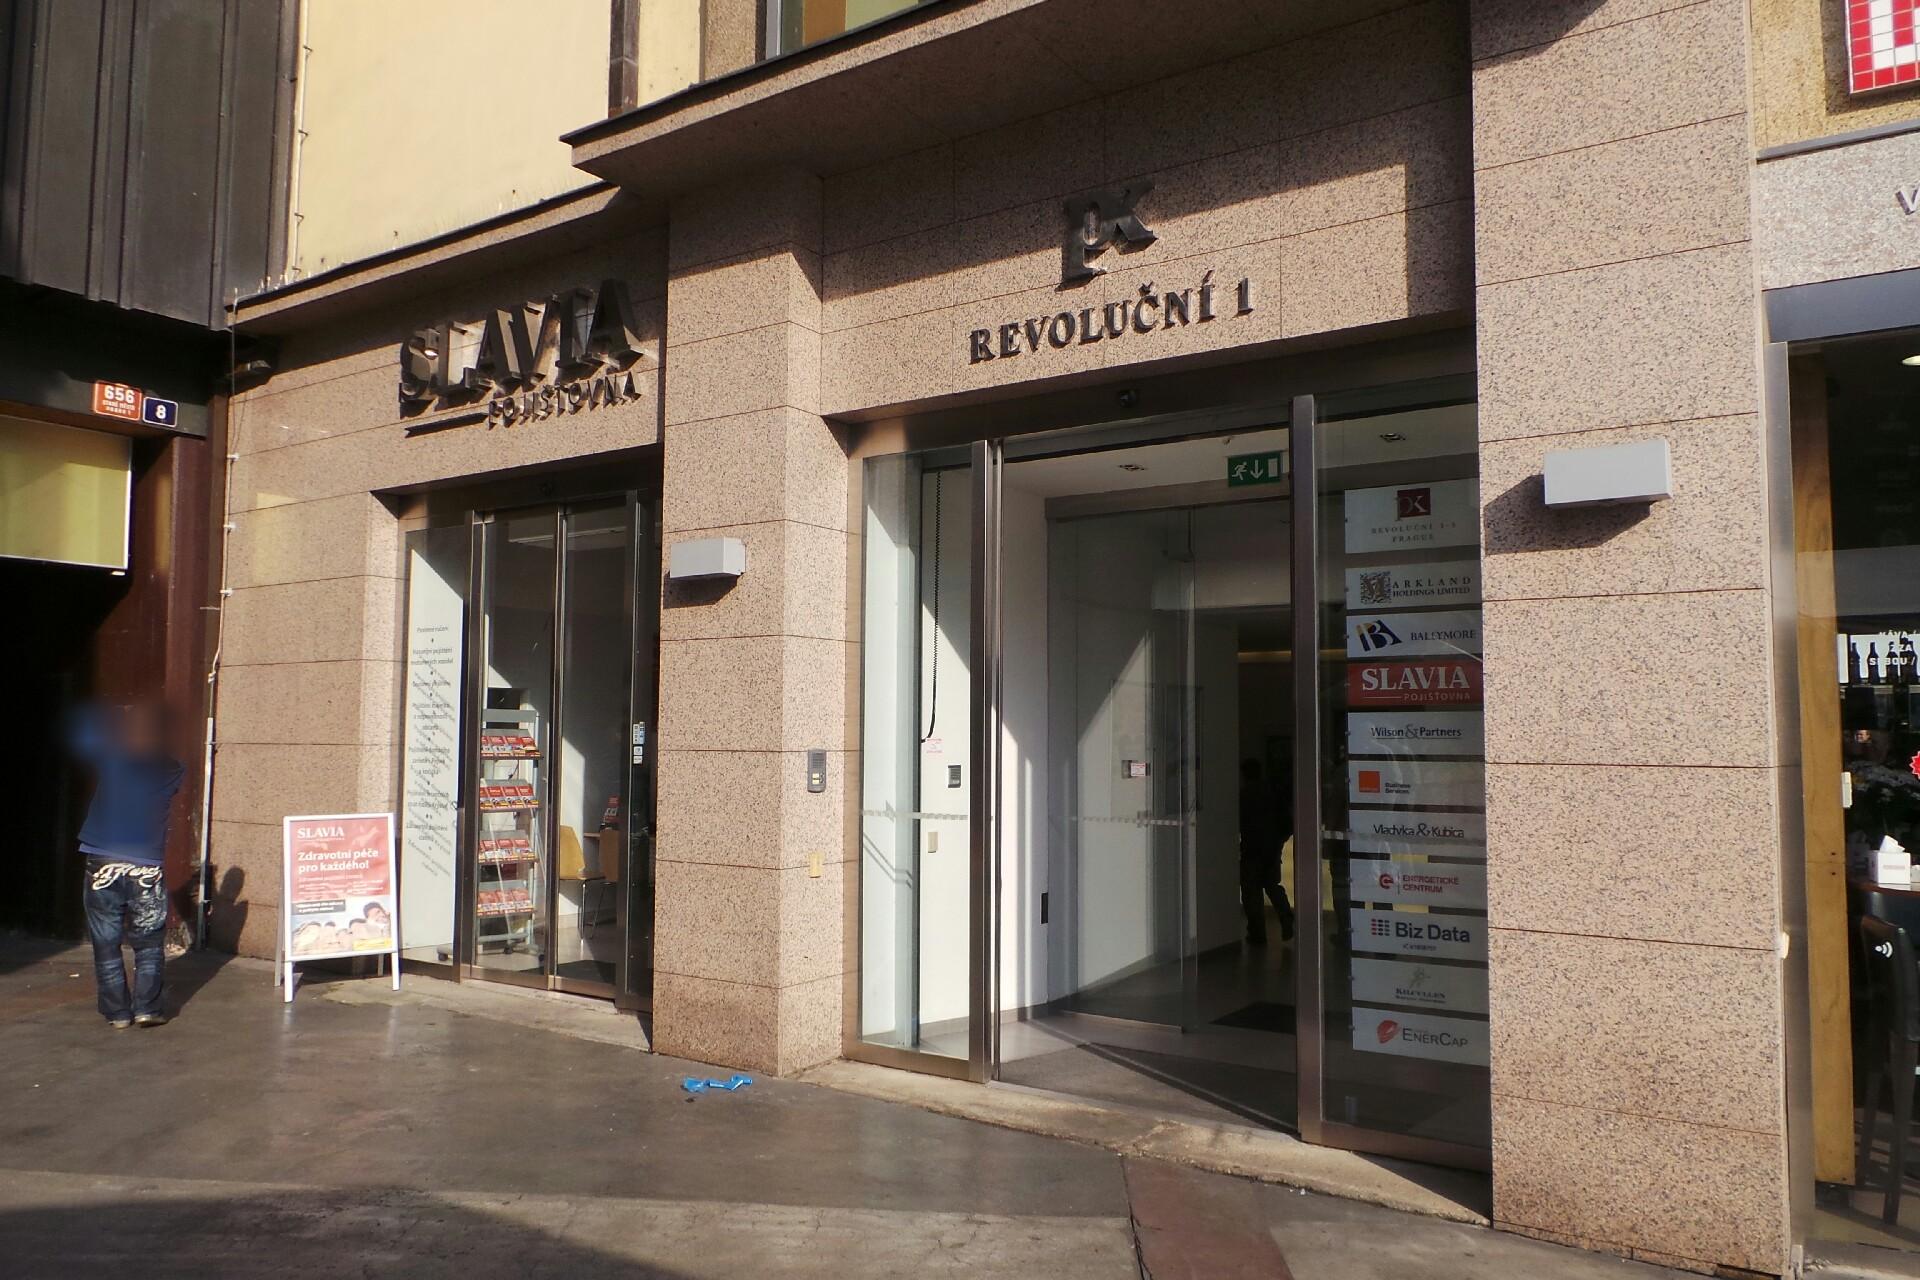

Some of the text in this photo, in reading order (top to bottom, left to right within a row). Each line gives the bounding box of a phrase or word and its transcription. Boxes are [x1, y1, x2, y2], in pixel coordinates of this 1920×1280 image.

[969, 269, 1252, 365] REVOLUČNÍ 1
[400, 279, 642, 405] SLAVIA
[104, 385, 135, 404] 656
[156, 404, 167, 419] 8
[1392, 577, 1471, 588] ARKLAND
[1392, 586, 1471, 597] HOLDINGS LIMITED
[1869, 656, 1908, 666] SBOU
[1361, 666, 1470, 691] SLAVIA
[297, 826, 345, 839] SLAVIA
[1431, 826, 1464, 839] Kubica
[298, 851, 351, 862] Zdravotní
[298, 862, 319, 875] pro
[1402, 883, 1443, 893] CENTRUM
[1395, 922, 1470, 943] Biz Data
